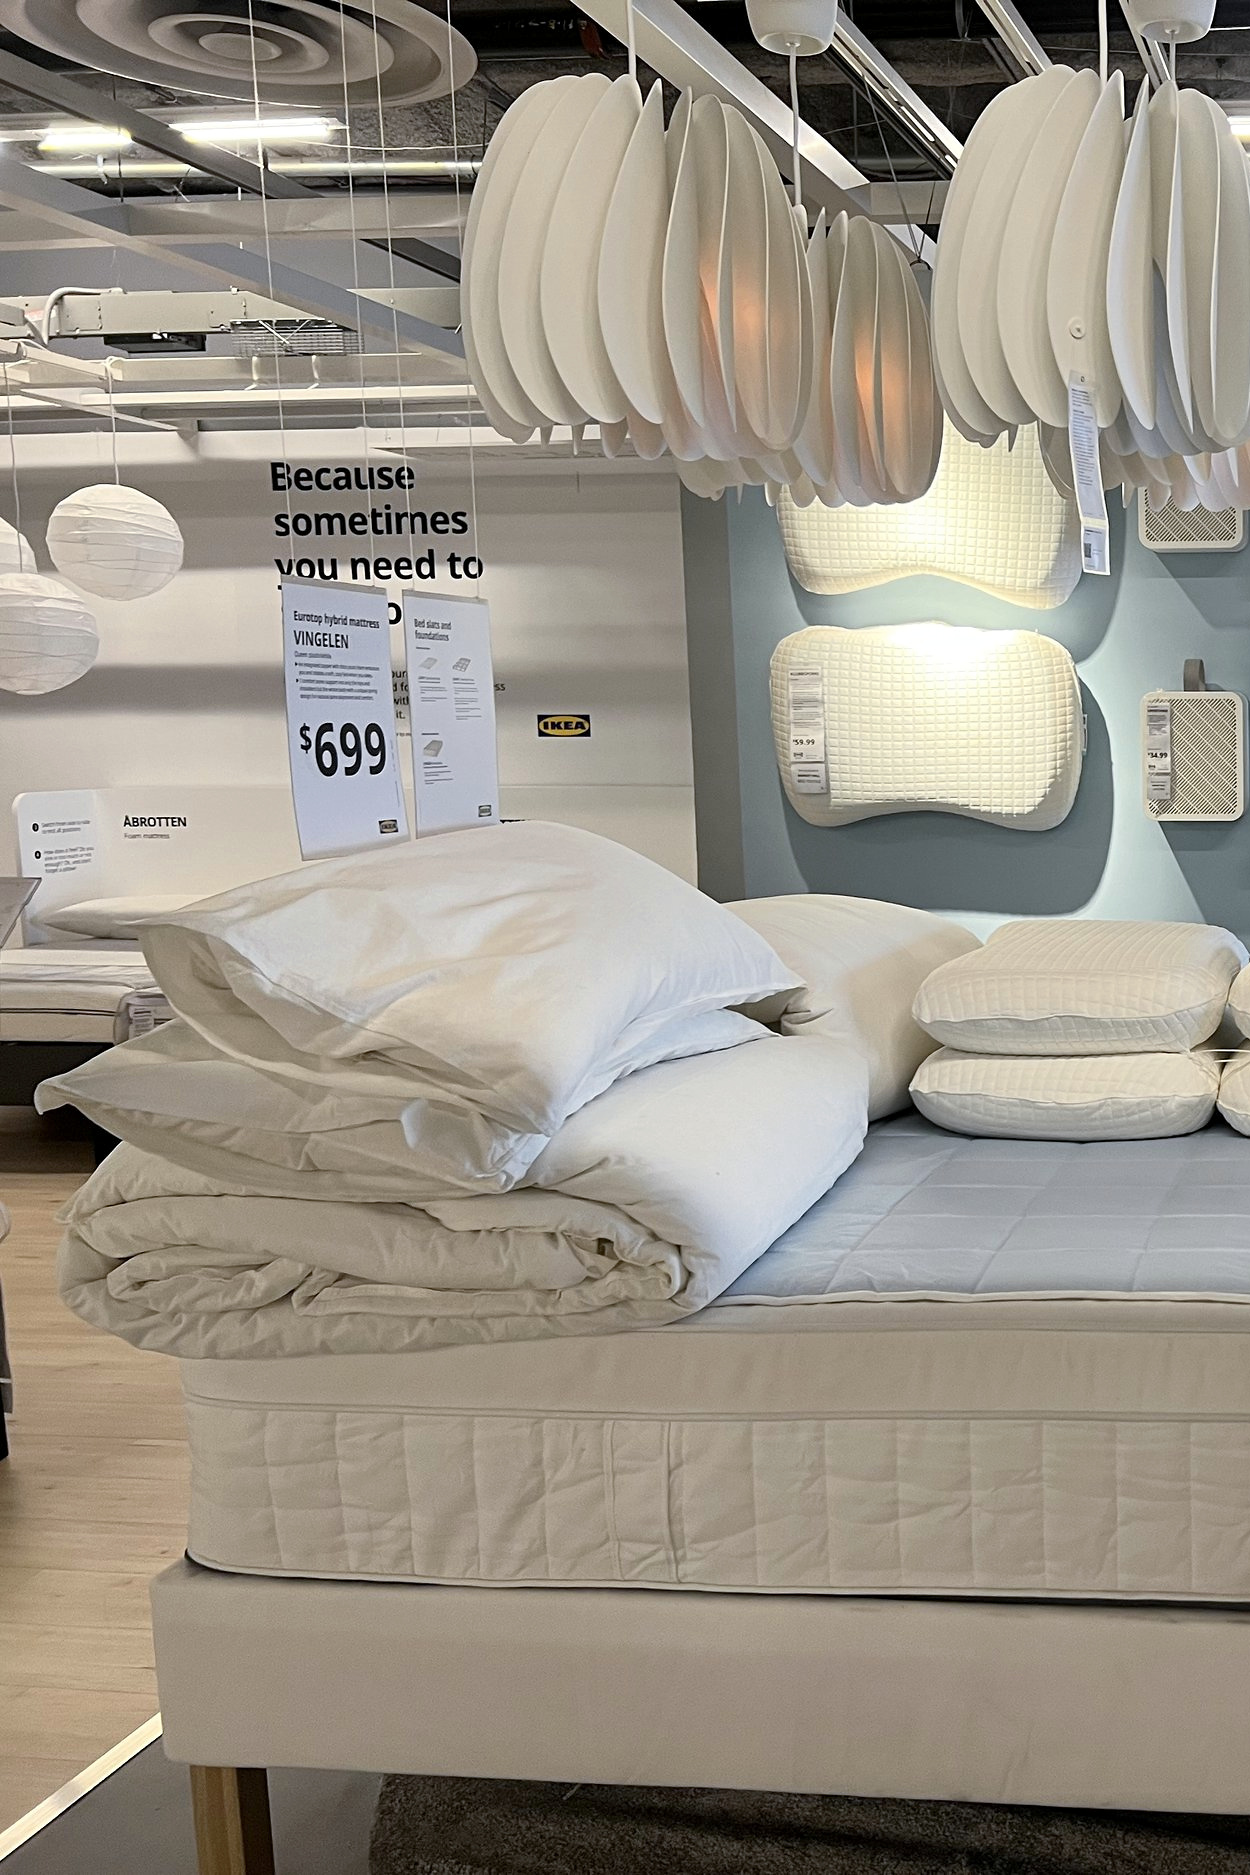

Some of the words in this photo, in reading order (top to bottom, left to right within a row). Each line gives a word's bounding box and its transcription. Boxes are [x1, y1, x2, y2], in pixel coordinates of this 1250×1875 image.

[270, 461, 415, 492] Because
[274, 504, 469, 537] sometimes
[273, 557, 338, 590] you
[350, 548, 435, 581] need
[446, 551, 484, 580] to
[293, 610, 323, 626] Eurotop
[324, 613, 348, 627] hybrid
[349, 617, 380, 629] mattress
[293, 630, 349, 649] VINGELEN
[543, 721, 587, 731] IKEA
[299, 721, 387, 778] $699
